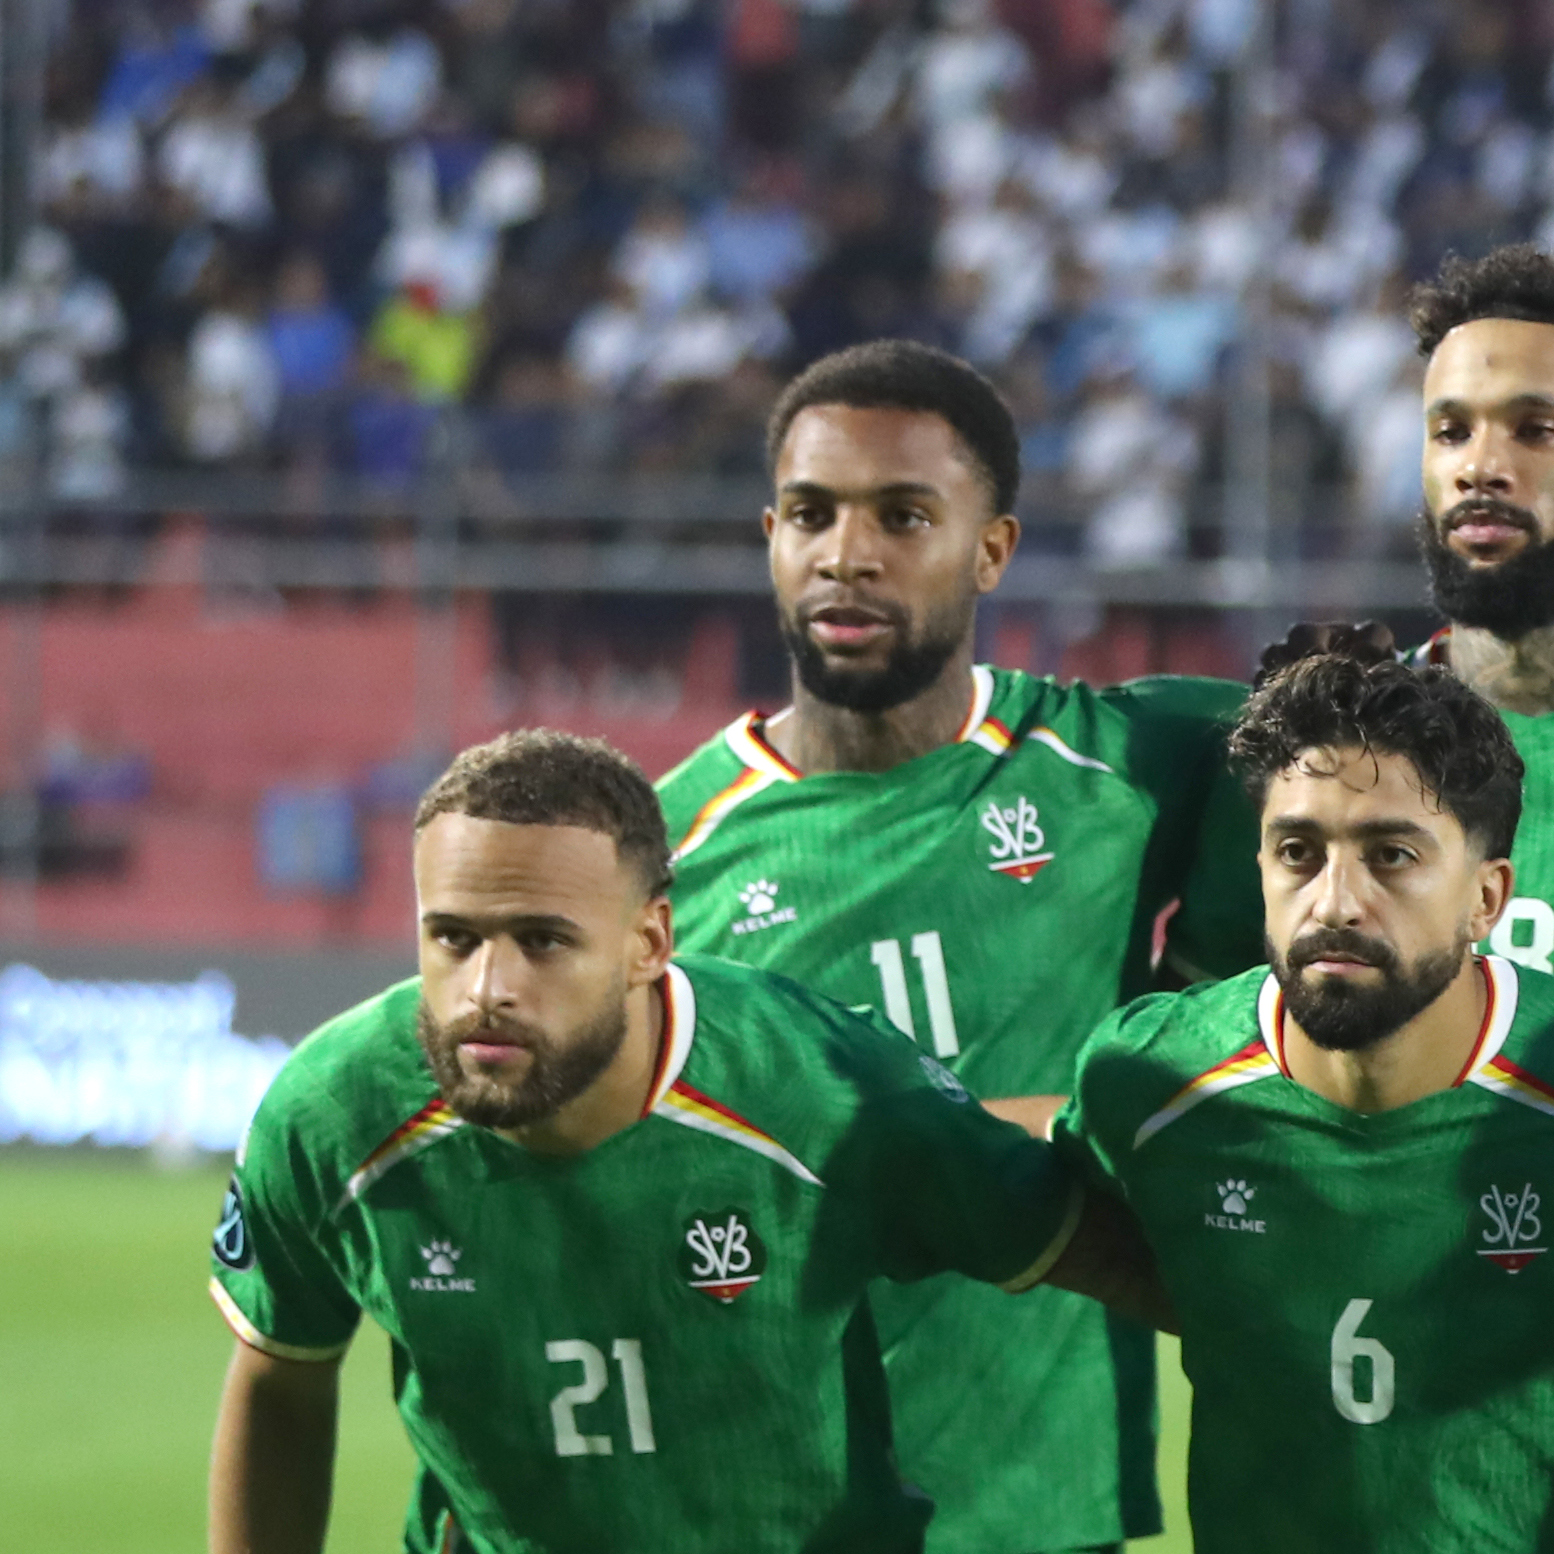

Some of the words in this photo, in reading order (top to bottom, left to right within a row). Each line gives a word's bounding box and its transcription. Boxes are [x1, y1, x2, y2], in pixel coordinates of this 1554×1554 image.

[732, 907, 797, 935] KELME
[871, 931, 960, 1058] 11
[1205, 1213, 1267, 1234] KELME
[410, 1277, 476, 1292] KELME
[545, 1338, 656, 1457] 21
[1330, 1298, 1395, 1426] 6
